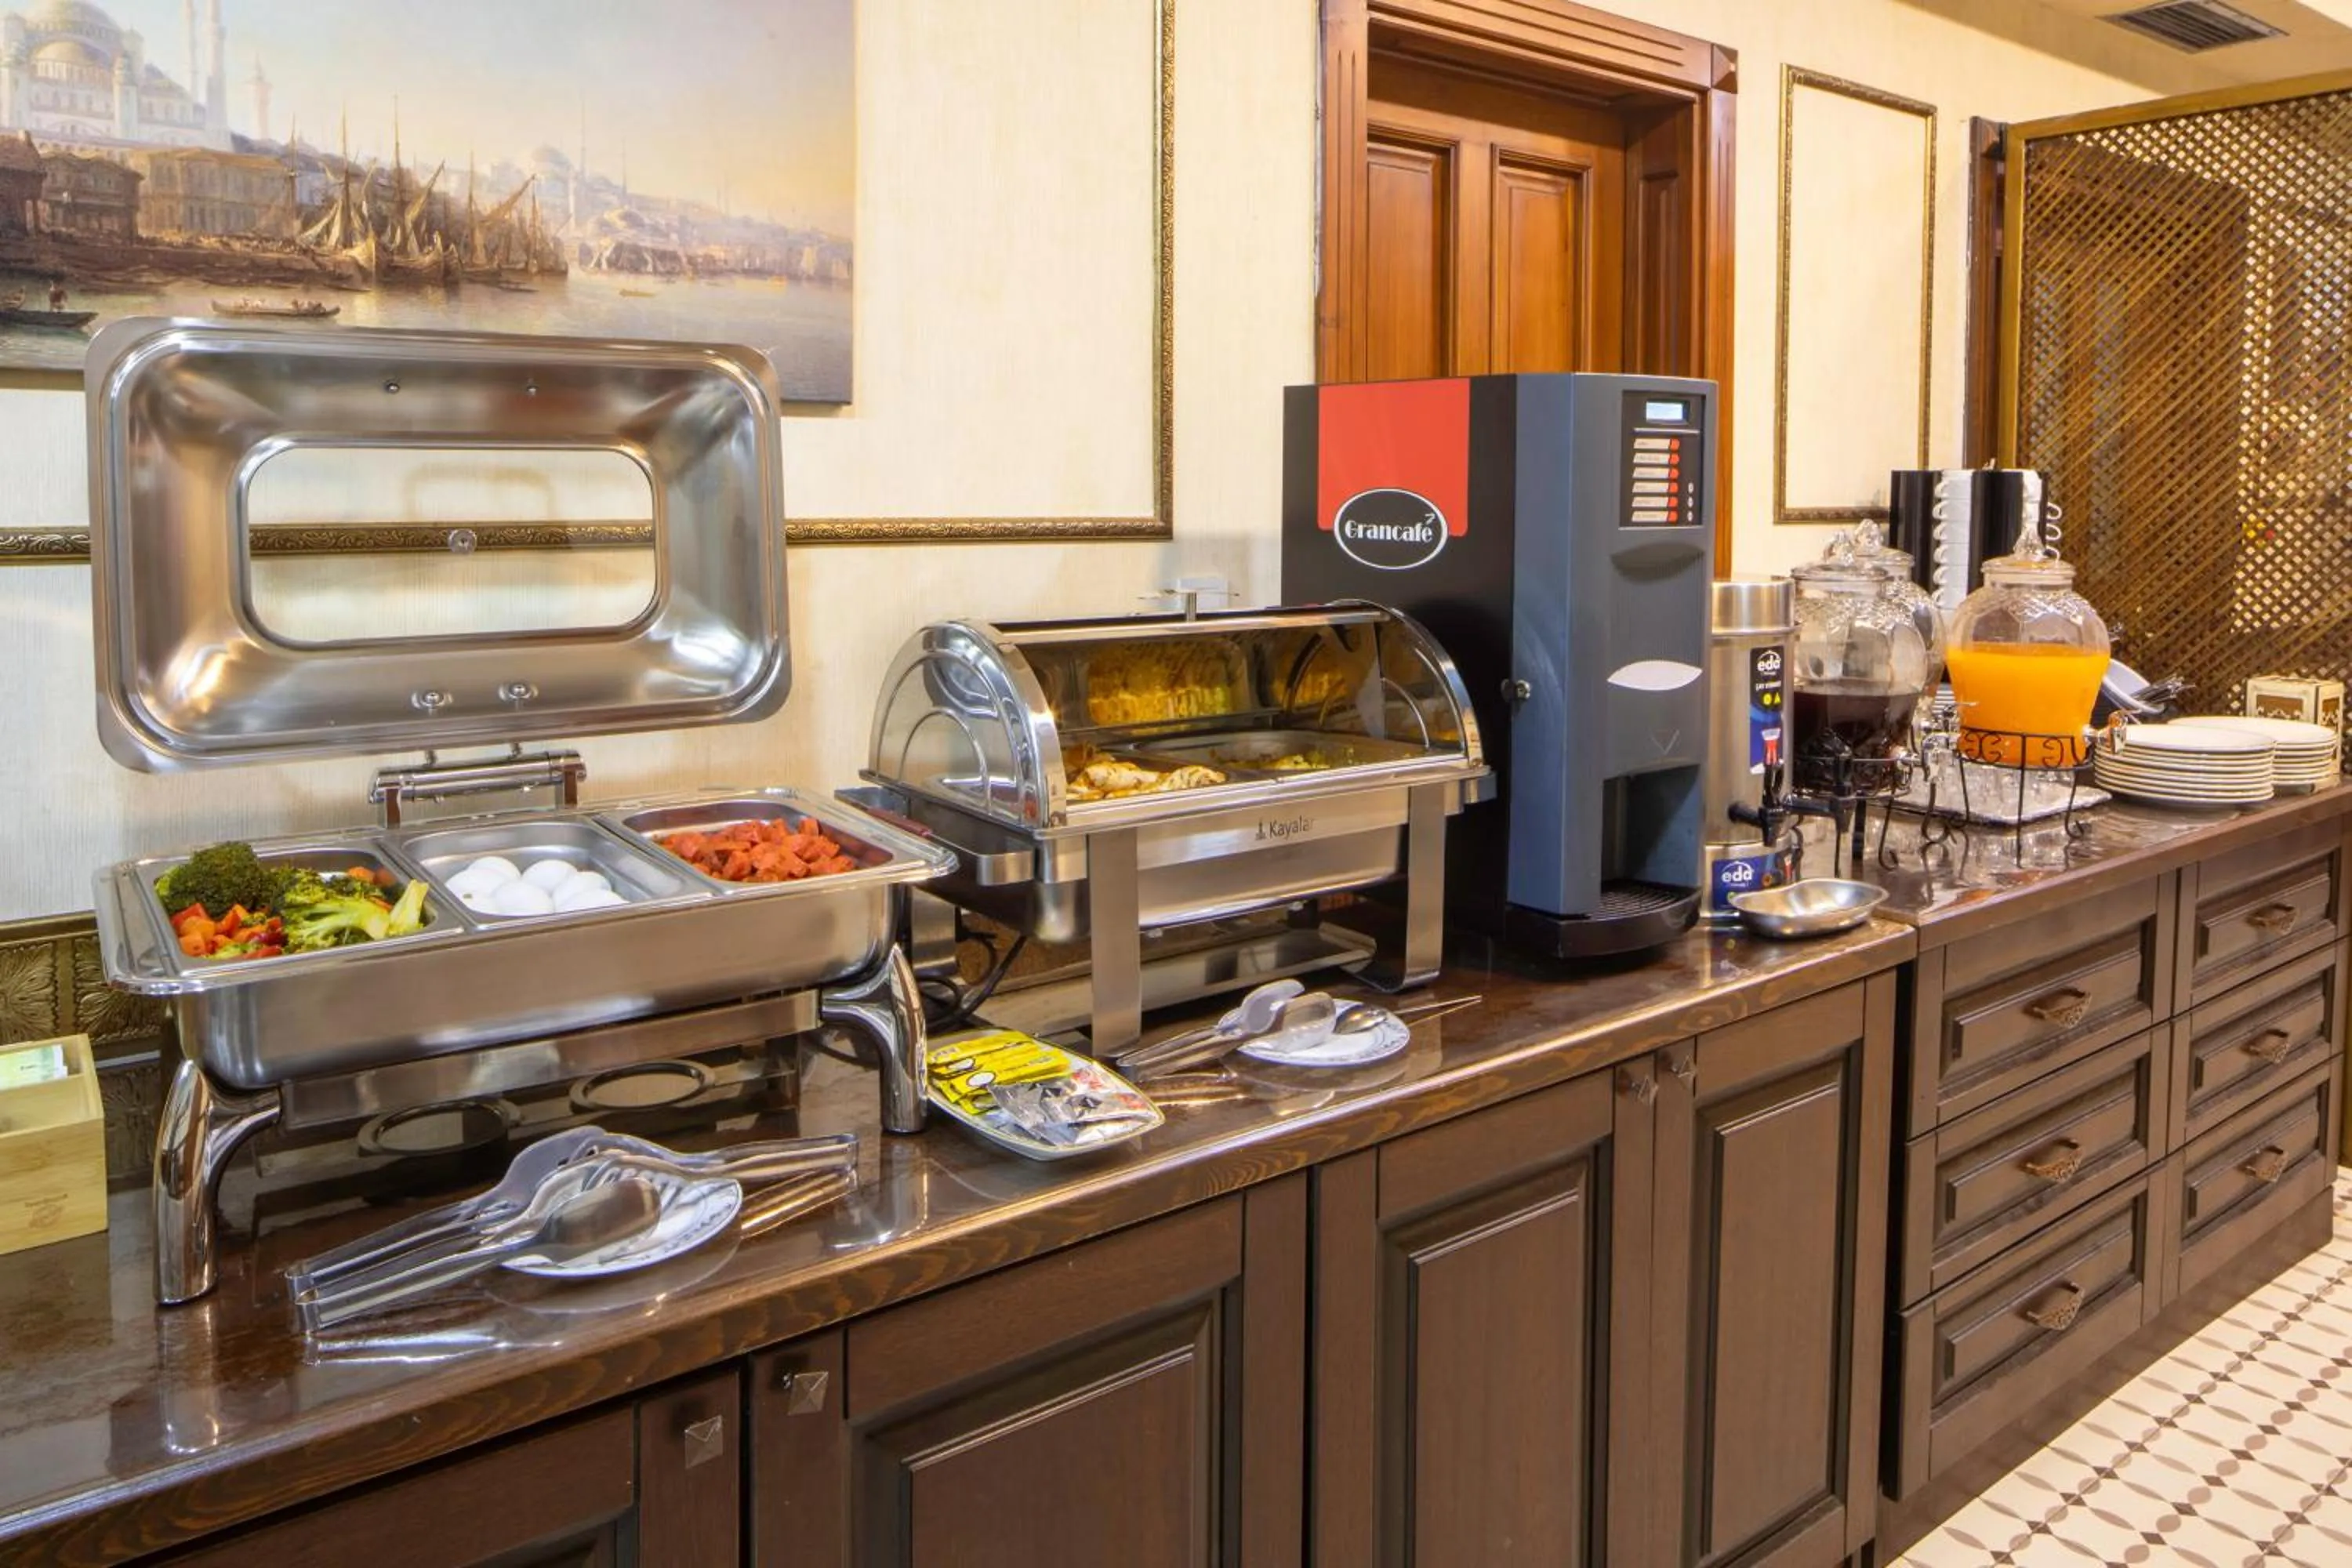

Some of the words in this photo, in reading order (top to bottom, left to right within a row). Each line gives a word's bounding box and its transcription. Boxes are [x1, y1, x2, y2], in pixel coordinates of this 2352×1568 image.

[1757, 655, 1780, 671] eda
[1269, 815, 1315, 840] Kayalar
[1721, 865, 1752, 883] eda
